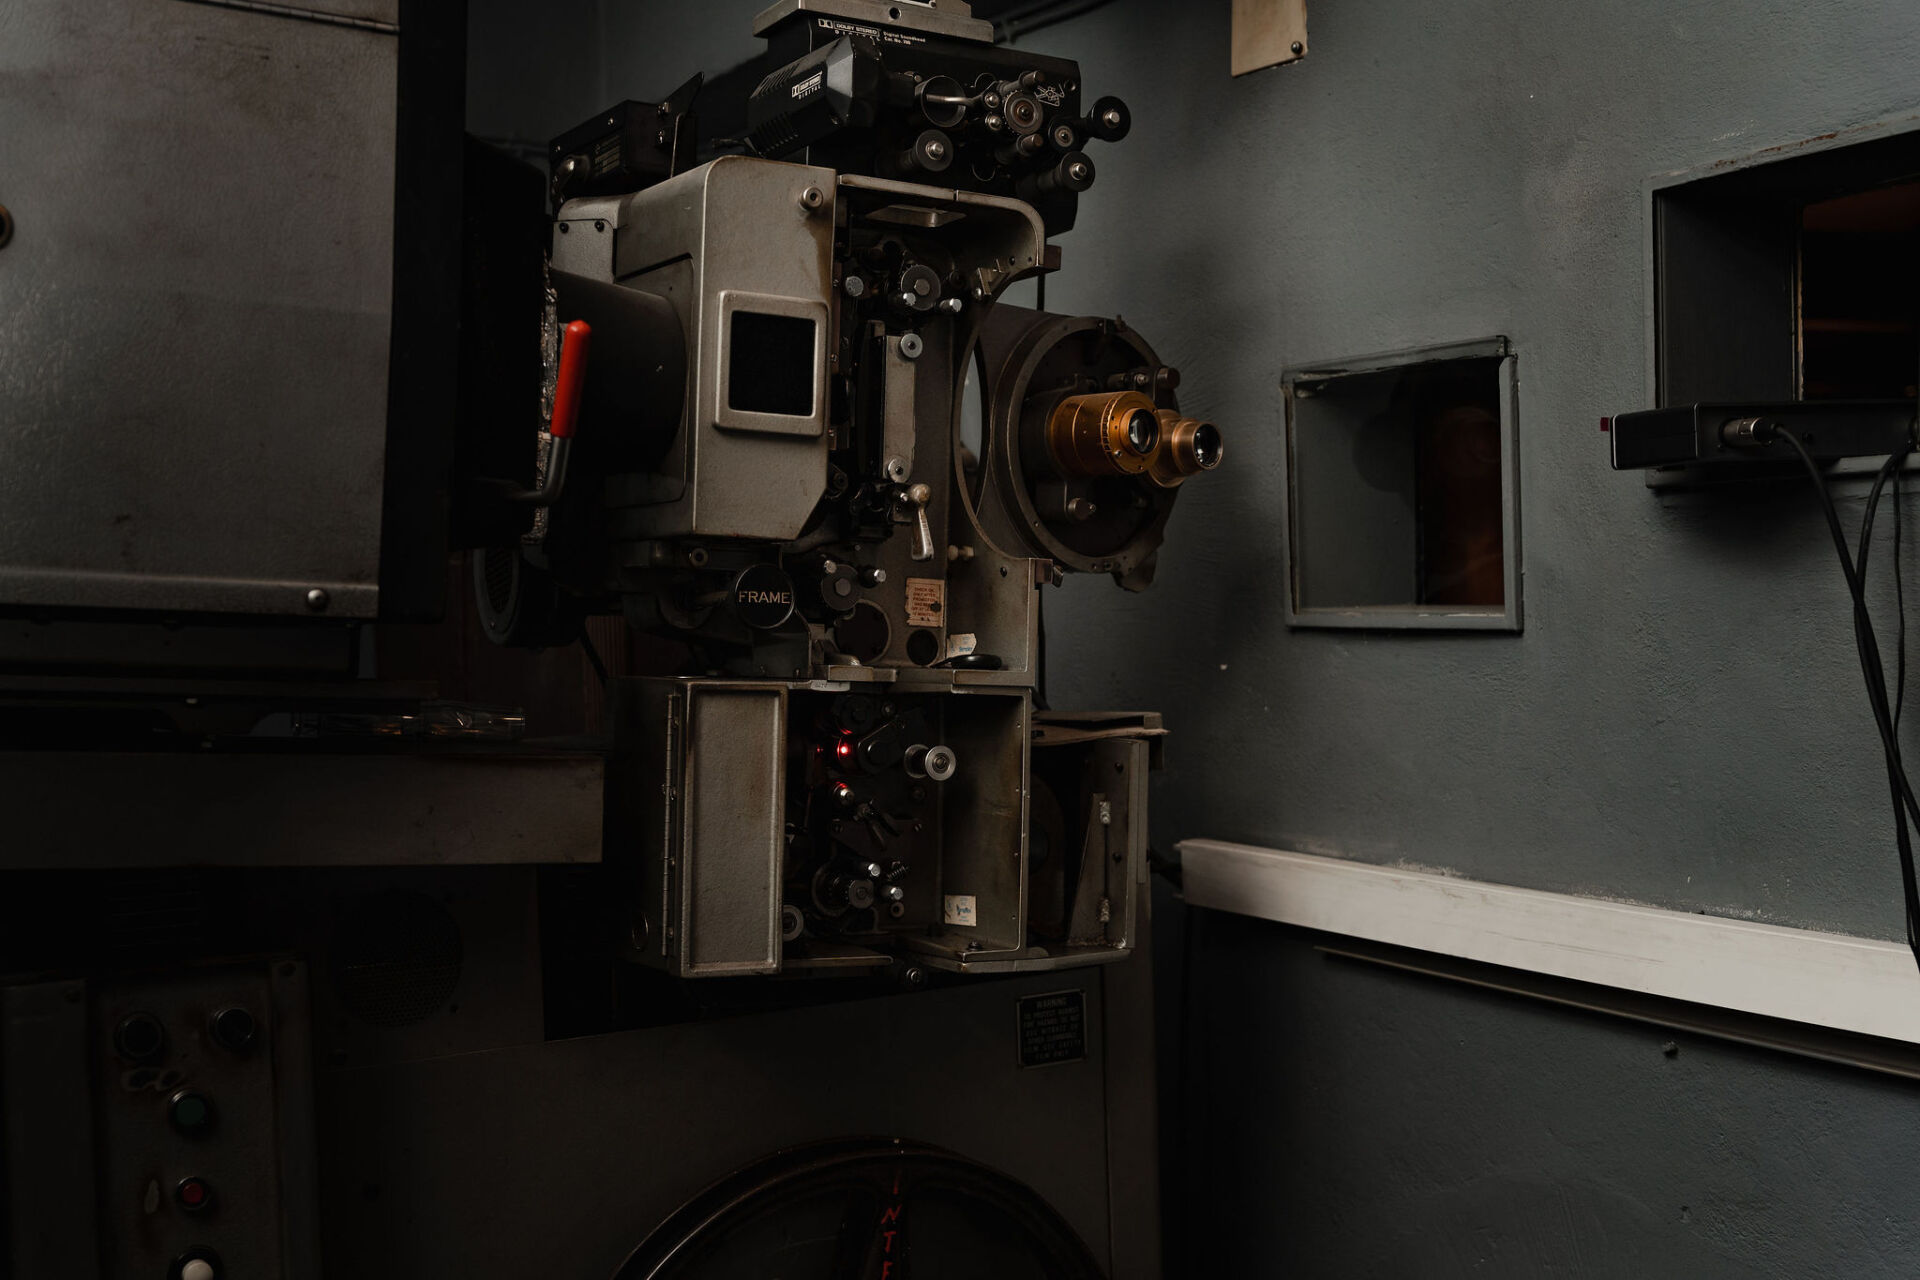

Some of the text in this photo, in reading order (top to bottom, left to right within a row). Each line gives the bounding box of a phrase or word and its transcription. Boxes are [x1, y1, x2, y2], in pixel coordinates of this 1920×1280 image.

[836, 23, 878, 35] DOLBY STEREO
[738, 590, 791, 604] FRAME
